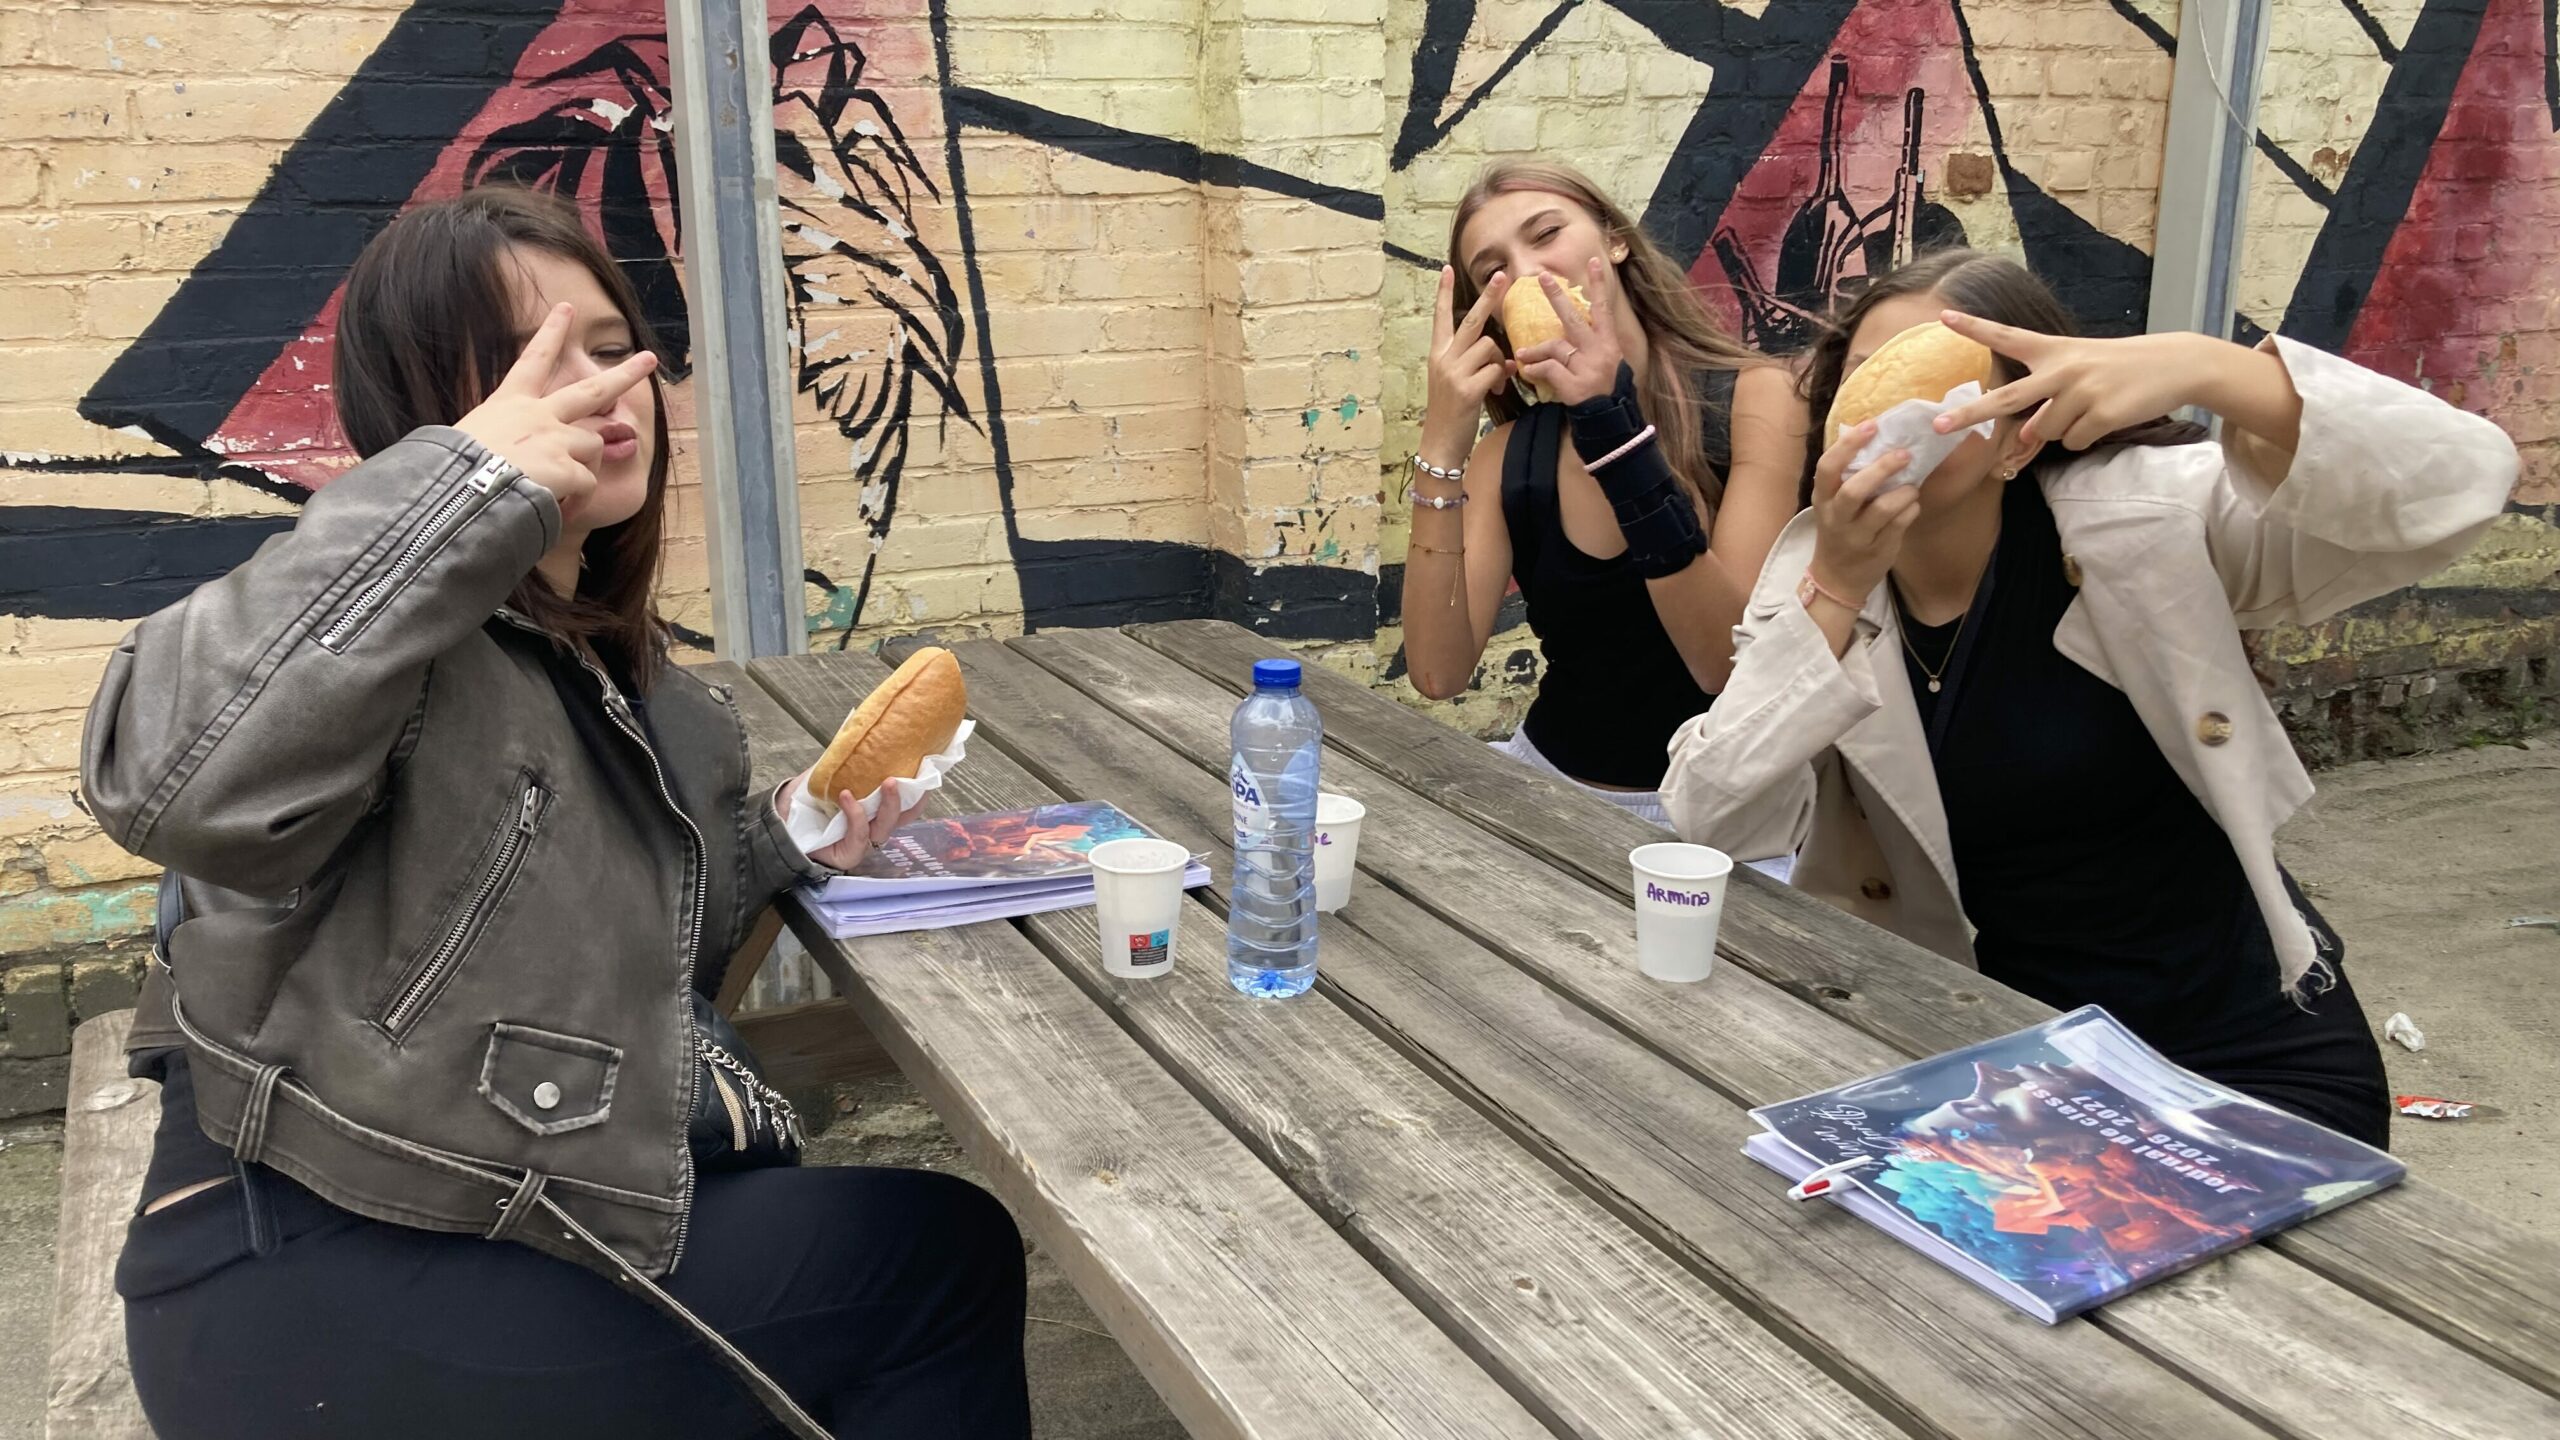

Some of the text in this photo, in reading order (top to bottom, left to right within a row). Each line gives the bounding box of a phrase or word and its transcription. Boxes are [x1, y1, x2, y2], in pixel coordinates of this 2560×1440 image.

[881, 848, 913, 867] 2026
[896, 835, 937, 861] Journal
[924, 862, 944, 870] de
[2070, 1095, 2136, 1127] 2027
[2019, 1080, 2238, 1194] Journal de classe
[2147, 1133, 2220, 1166] 2026
